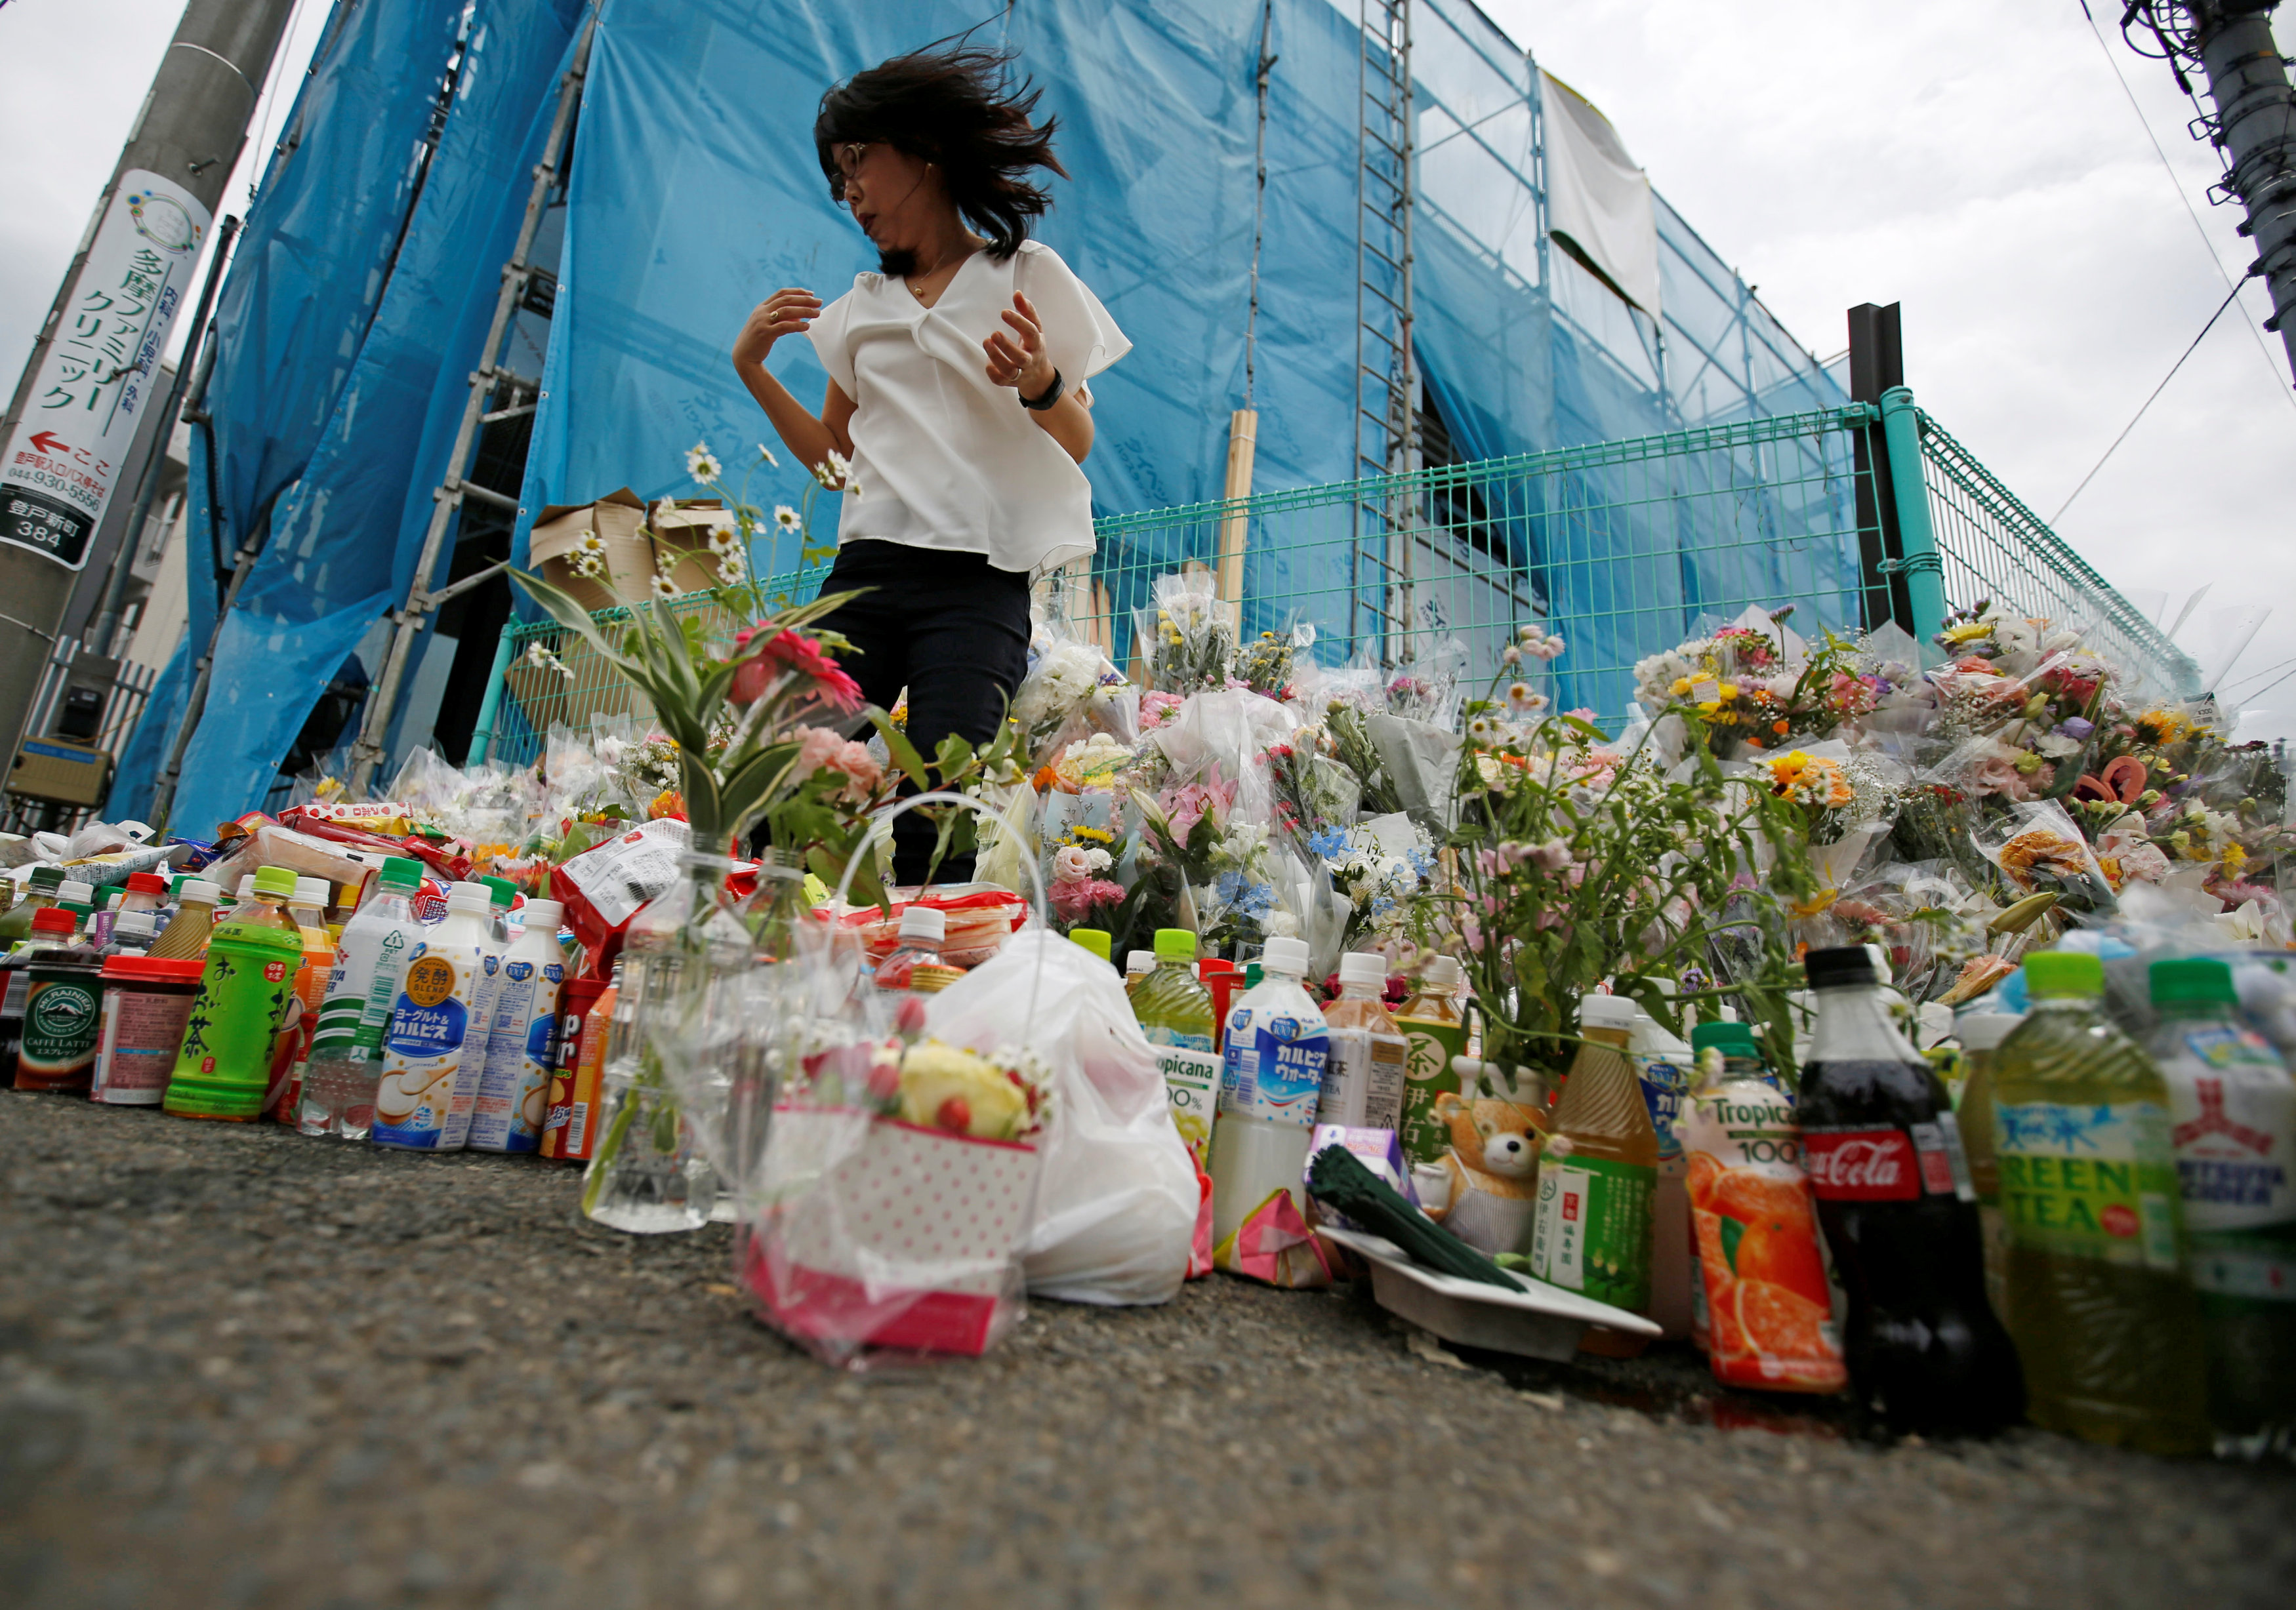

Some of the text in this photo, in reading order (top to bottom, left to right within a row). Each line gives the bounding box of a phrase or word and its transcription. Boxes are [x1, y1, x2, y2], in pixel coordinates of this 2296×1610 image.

[87, 249, 164, 412] 多摩ファミリー
[41, 291, 115, 409] クリニック
[73, 447, 110, 477] ここ
[8, 468, 101, 512] 044-930-5556
[7, 499, 81, 537] 登戸新町
[16, 521, 62, 548] 384
[353, 807, 379, 817] アポロ
[415, 967, 449, 986] 発酵
[184, 980, 213, 1060] お茶
[392, 1020, 448, 1040] カルピス
[396, 1009, 449, 1025] ヨーグルト&
[37, 1048, 78, 1057] エスプレッソ
[1277, 1044, 1328, 1069] カルピス
[1325, 1083, 1342, 1095] TEA
[1738, 1140, 1796, 1165] 100
[1999, 1155, 2131, 1196] REEN
[2009, 1192, 2099, 1234] TEA
